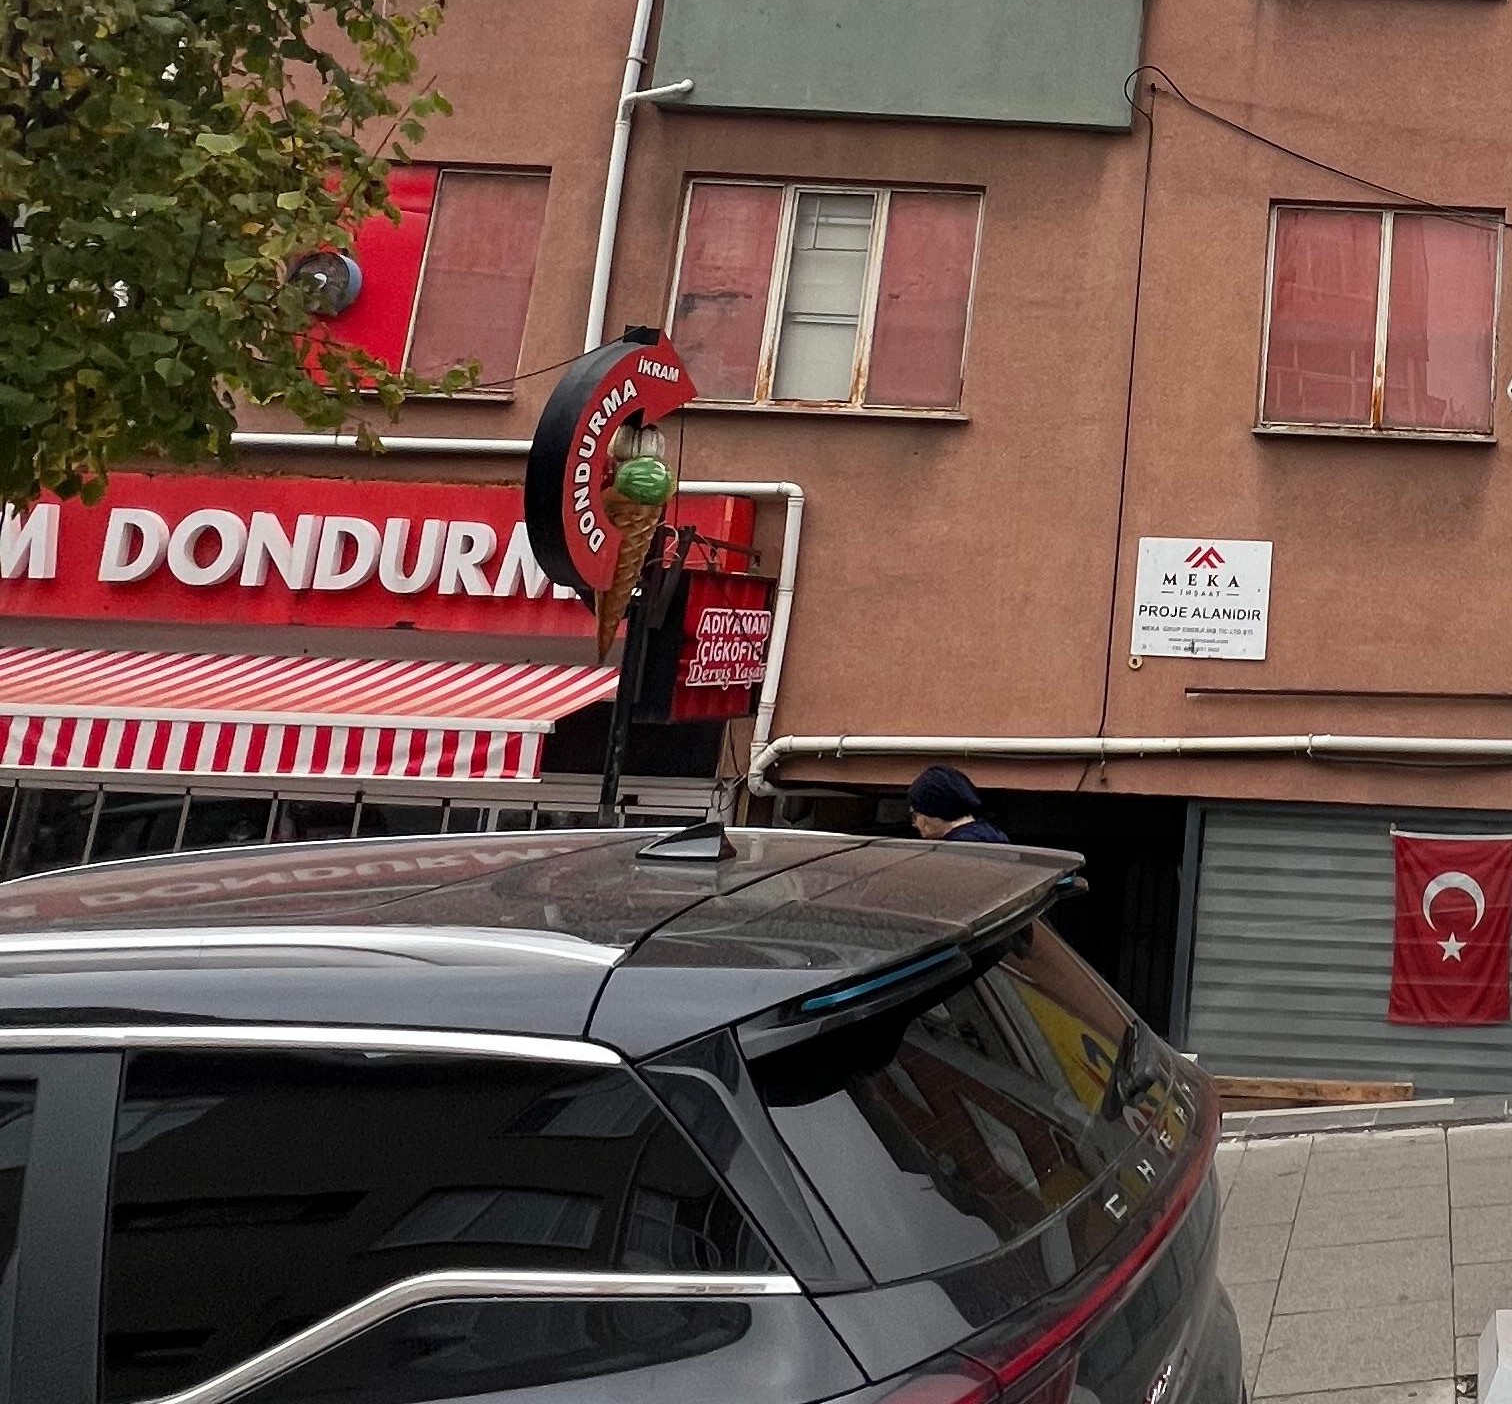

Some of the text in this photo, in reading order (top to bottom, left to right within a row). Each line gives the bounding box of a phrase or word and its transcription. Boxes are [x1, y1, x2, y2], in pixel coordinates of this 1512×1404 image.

[637, 355, 680, 383] İKRAM
[573, 378, 638, 553] DONDURMA
[0, 502, 582, 600] M DONDURM
[1162, 572, 1240, 588] MEKA
[701, 614, 768, 635] ADIYAMAN
[1138, 604, 1262, 621] PROJE ALANIDIR
